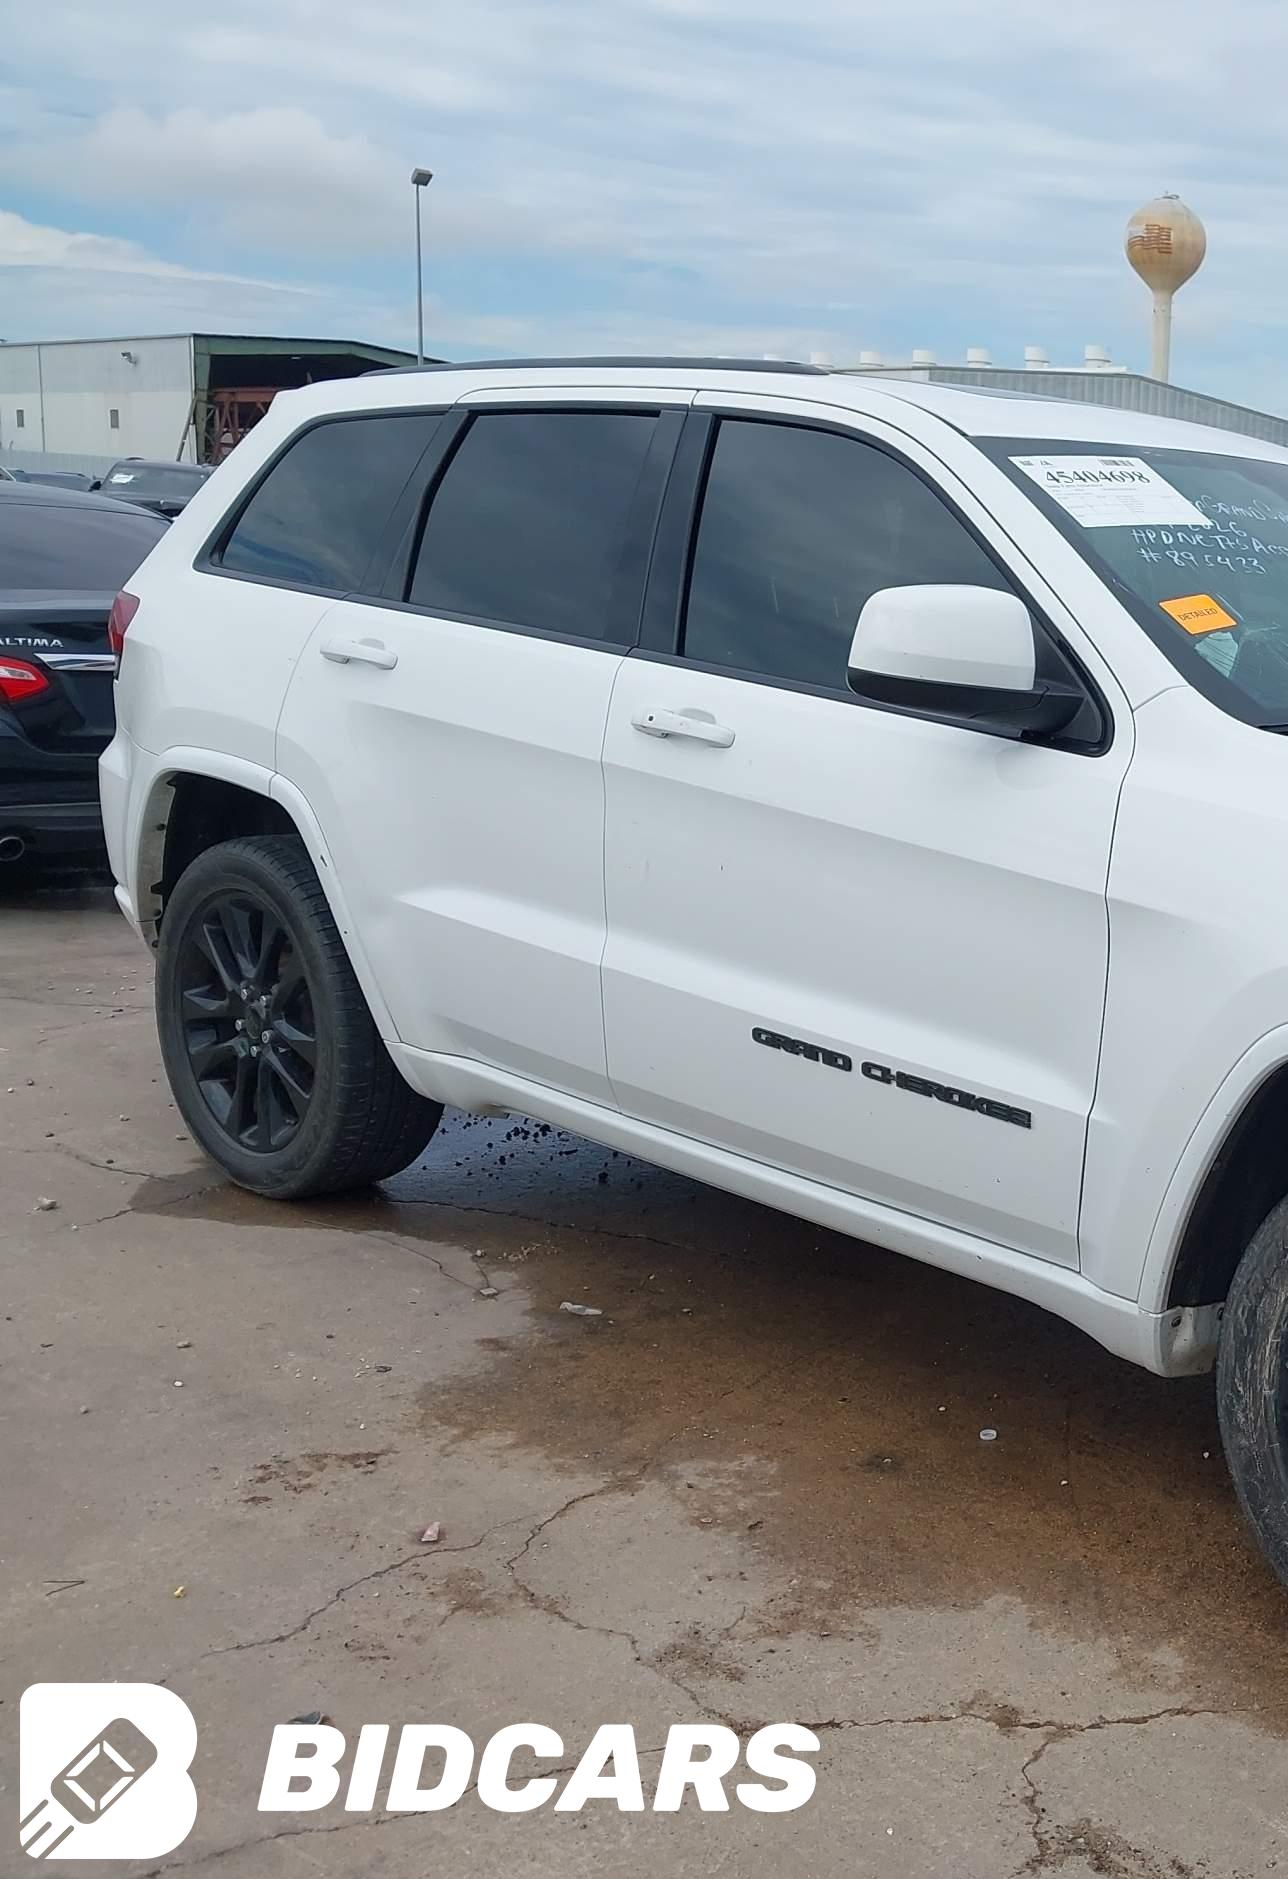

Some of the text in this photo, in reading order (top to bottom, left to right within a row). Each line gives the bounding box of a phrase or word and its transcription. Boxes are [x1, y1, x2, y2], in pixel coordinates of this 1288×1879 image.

[1046, 470, 1151, 484] 45404698
[1177, 607, 1218, 621] DETAILED
[751, 1026, 1032, 1129] GRAND CHEROKEE
